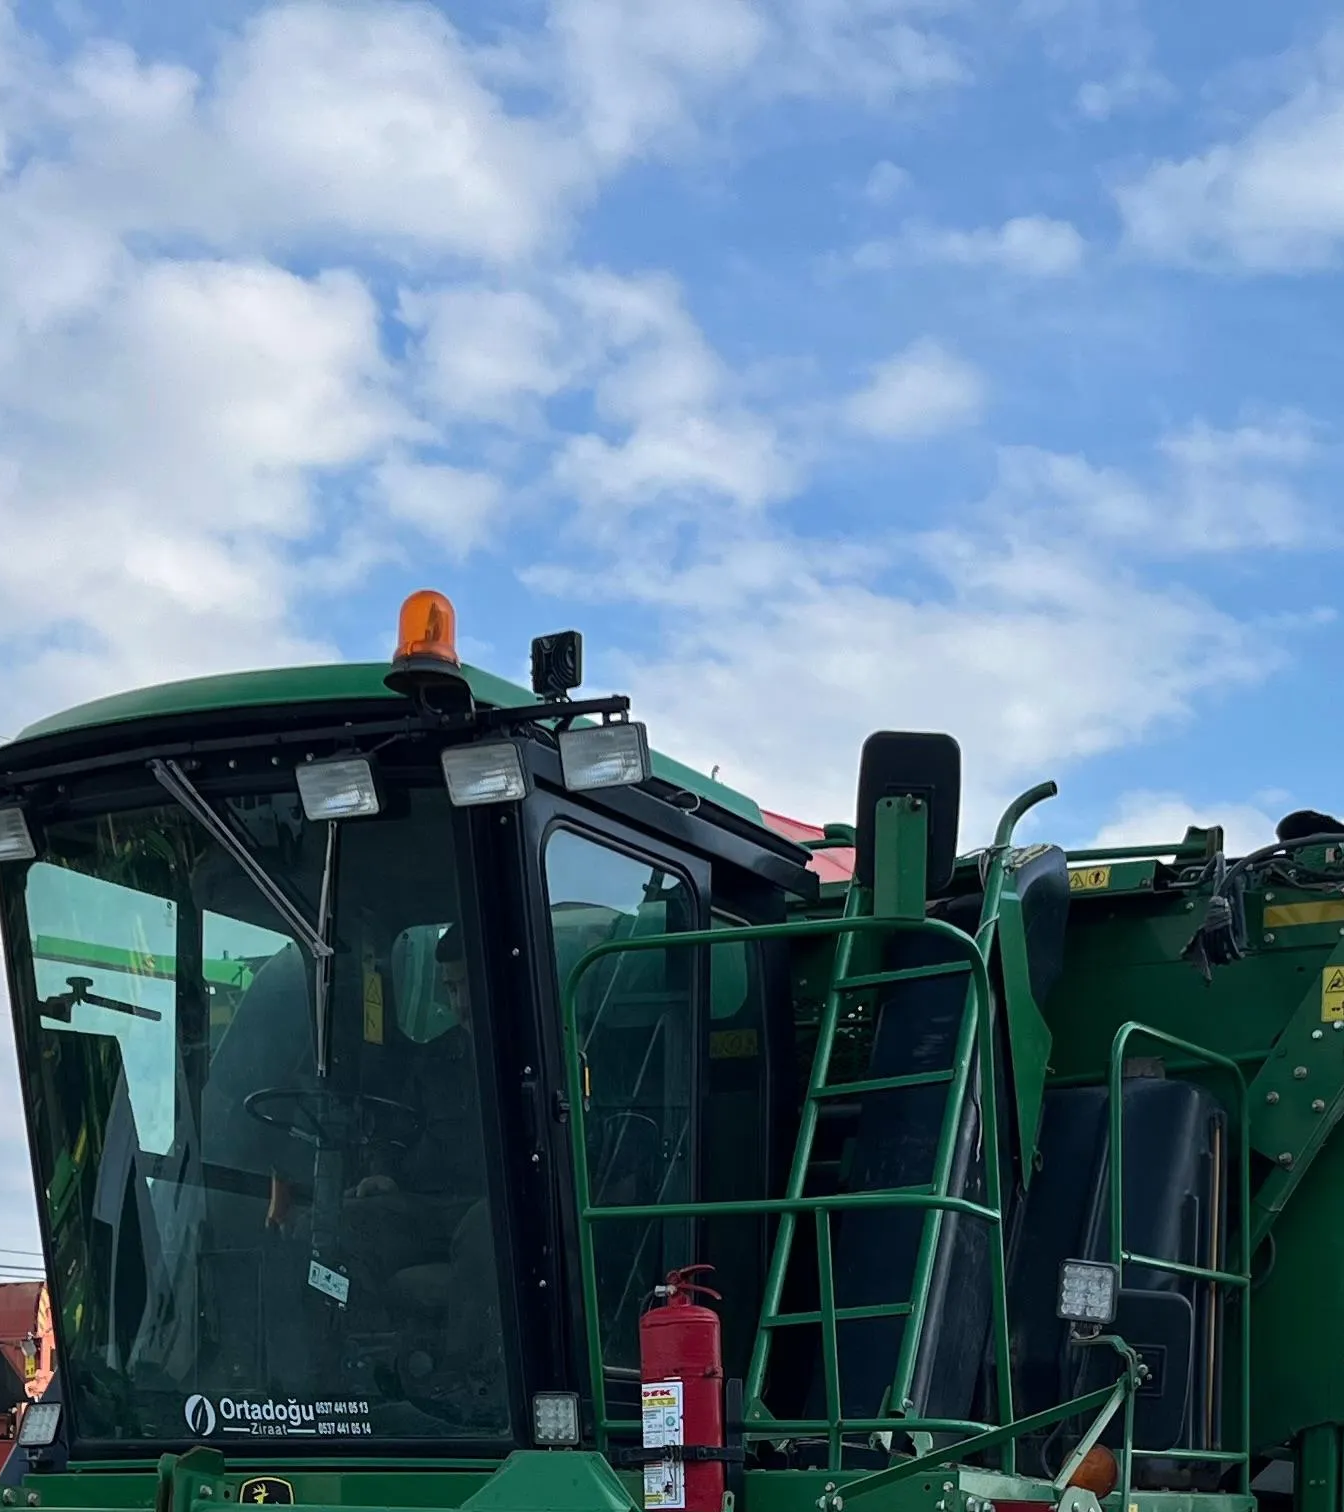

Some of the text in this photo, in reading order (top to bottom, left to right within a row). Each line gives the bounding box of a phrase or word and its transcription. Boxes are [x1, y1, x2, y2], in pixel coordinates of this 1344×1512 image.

[219, 1397, 316, 1427] Ortadoğu
[334, 1401, 347, 1415] 441
[359, 1401, 369, 1415] 13
[250, 1422, 288, 1436] Ziraat
[362, 1422, 372, 1435] 14
